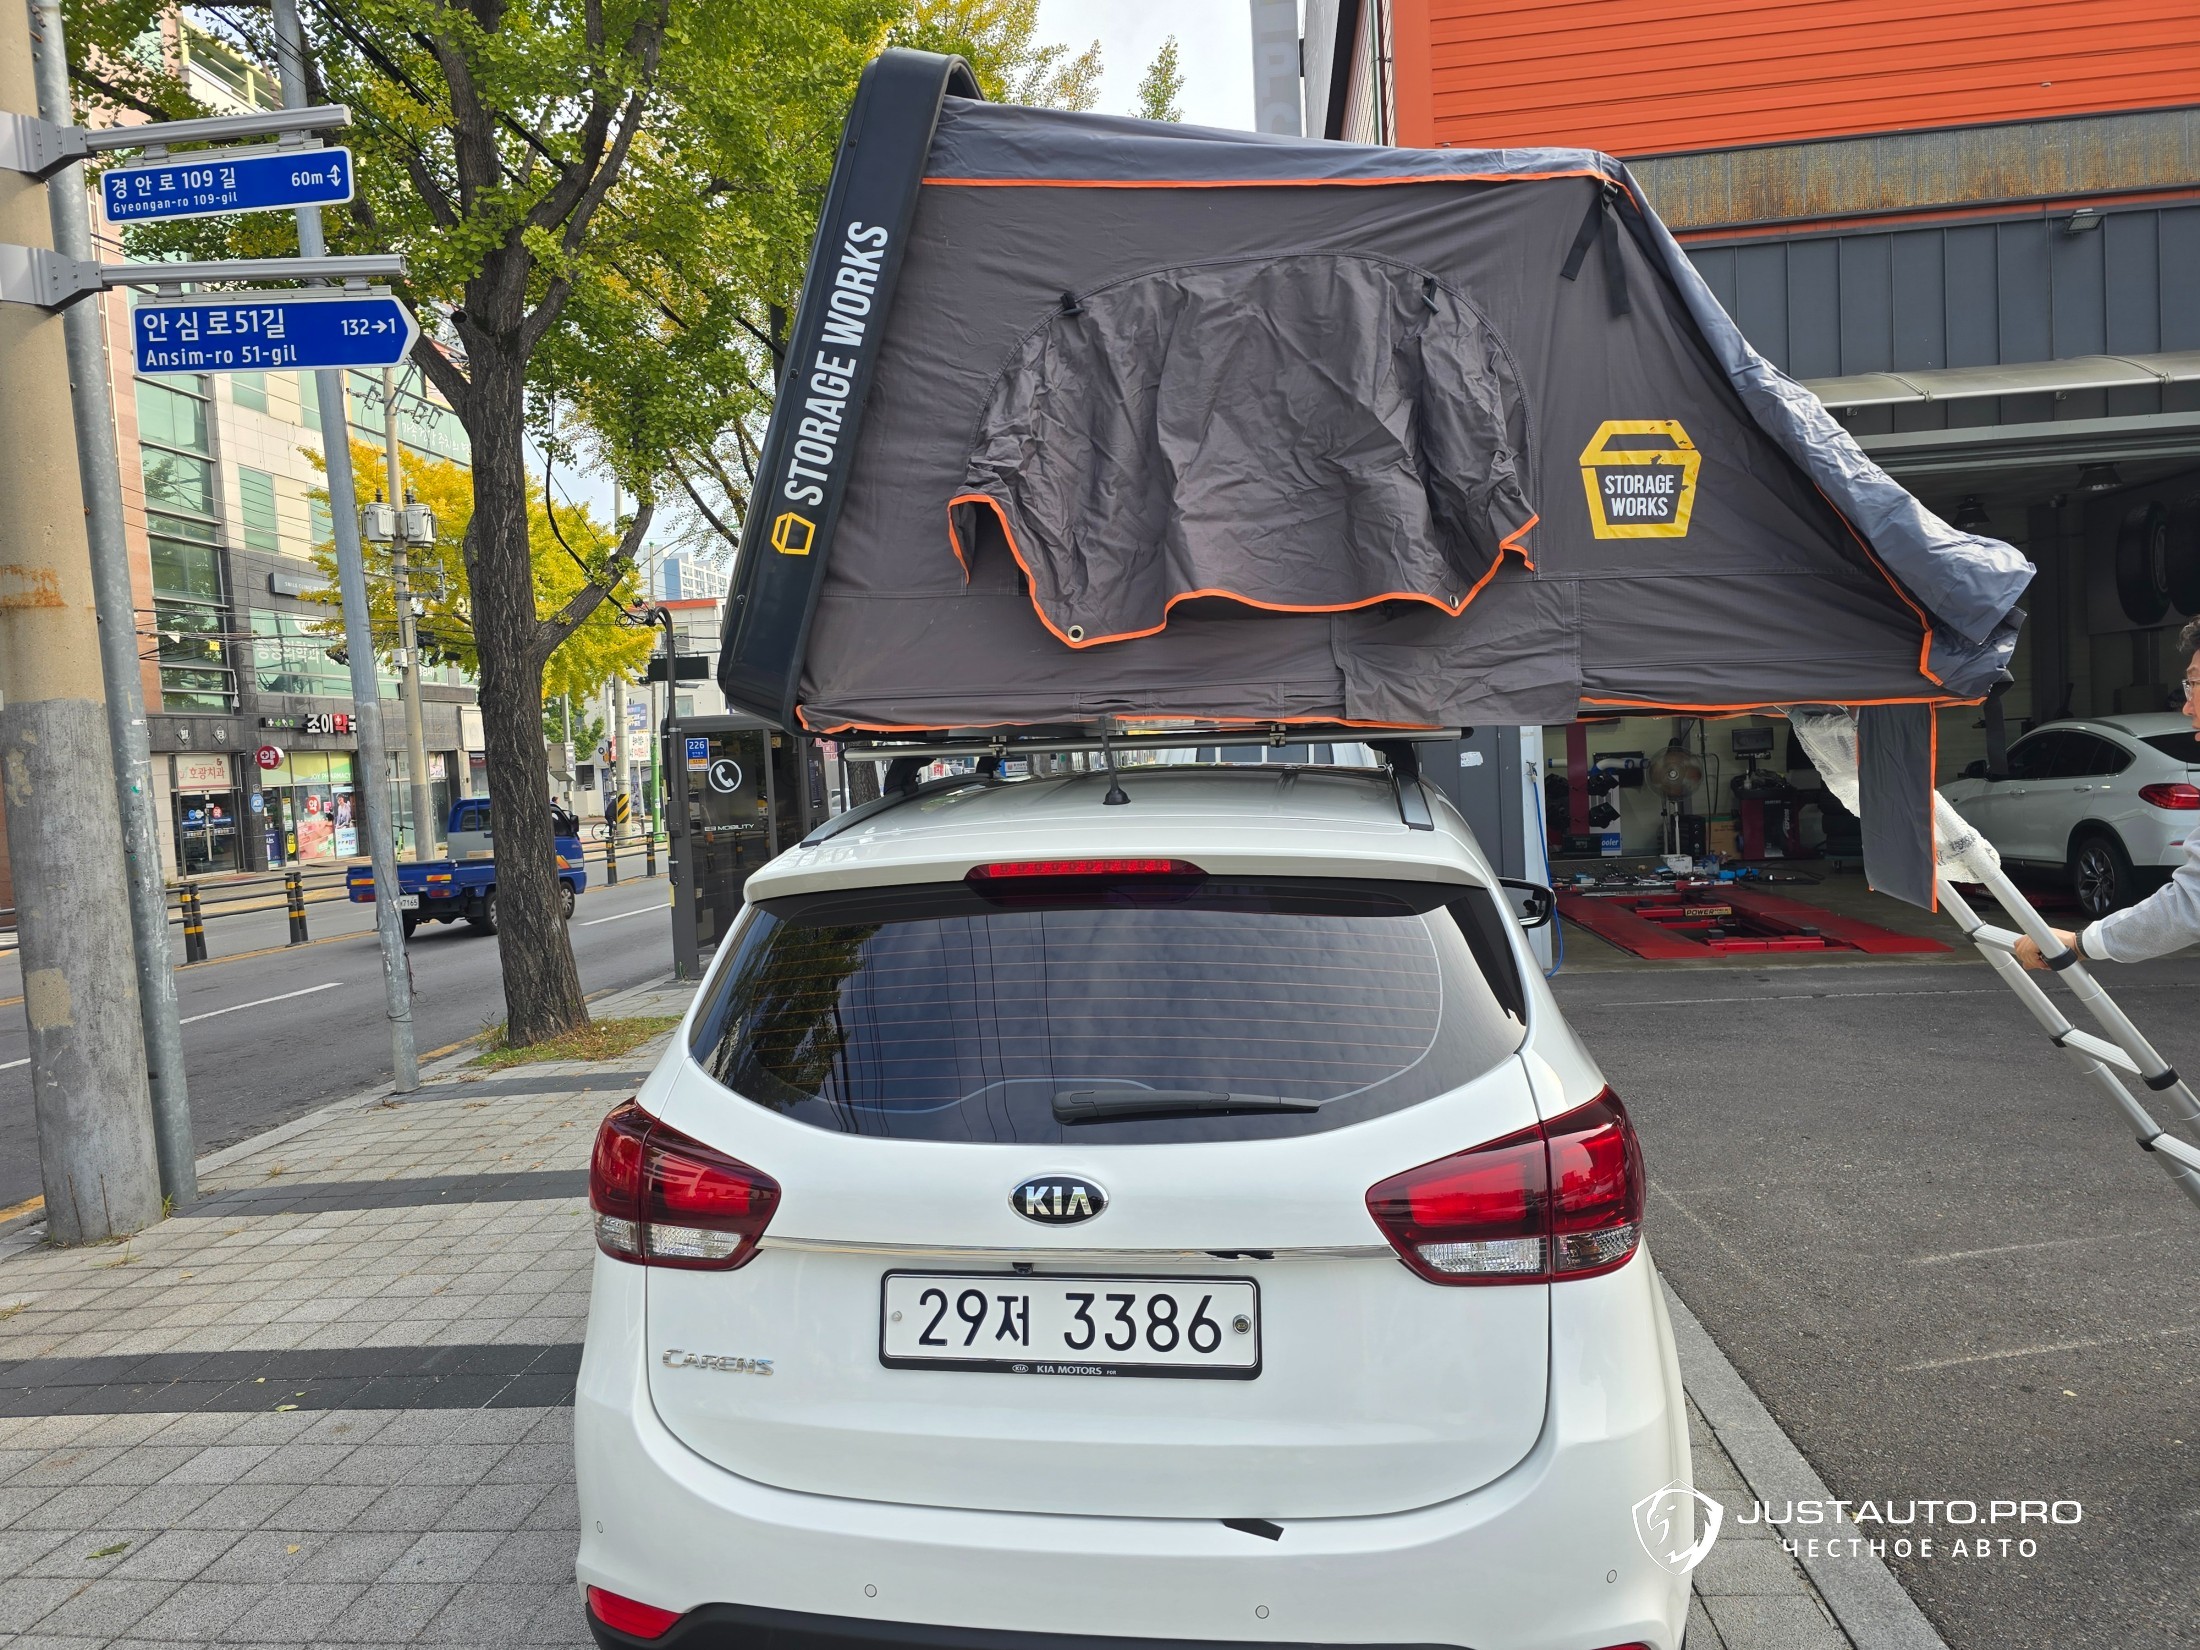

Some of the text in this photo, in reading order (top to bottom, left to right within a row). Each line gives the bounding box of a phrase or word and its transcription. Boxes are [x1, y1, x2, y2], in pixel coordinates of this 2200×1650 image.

[292, 171, 323, 187] 60m
[113, 191, 238, 214] Gyeongan-ro 109-gil
[145, 344, 297, 367] Ansim-ro 51-gil
[784, 221, 889, 506] STORAGE WORKS
[1604, 474, 1675, 495] STORAGE
[1611, 497, 1669, 517] WORKS
[689, 741, 705, 750] 226
[260, 750, 276, 766] 약
[189, 766, 225, 780] 호광치과
[717, 823, 755, 831] MOBILITY
[1025, 1186, 1093, 1216] KIA
[918, 1288, 1222, 1354] 29저 3386
[1036, 1365, 1055, 1374] KIA
[1057, 1365, 1103, 1376] MOTORS
